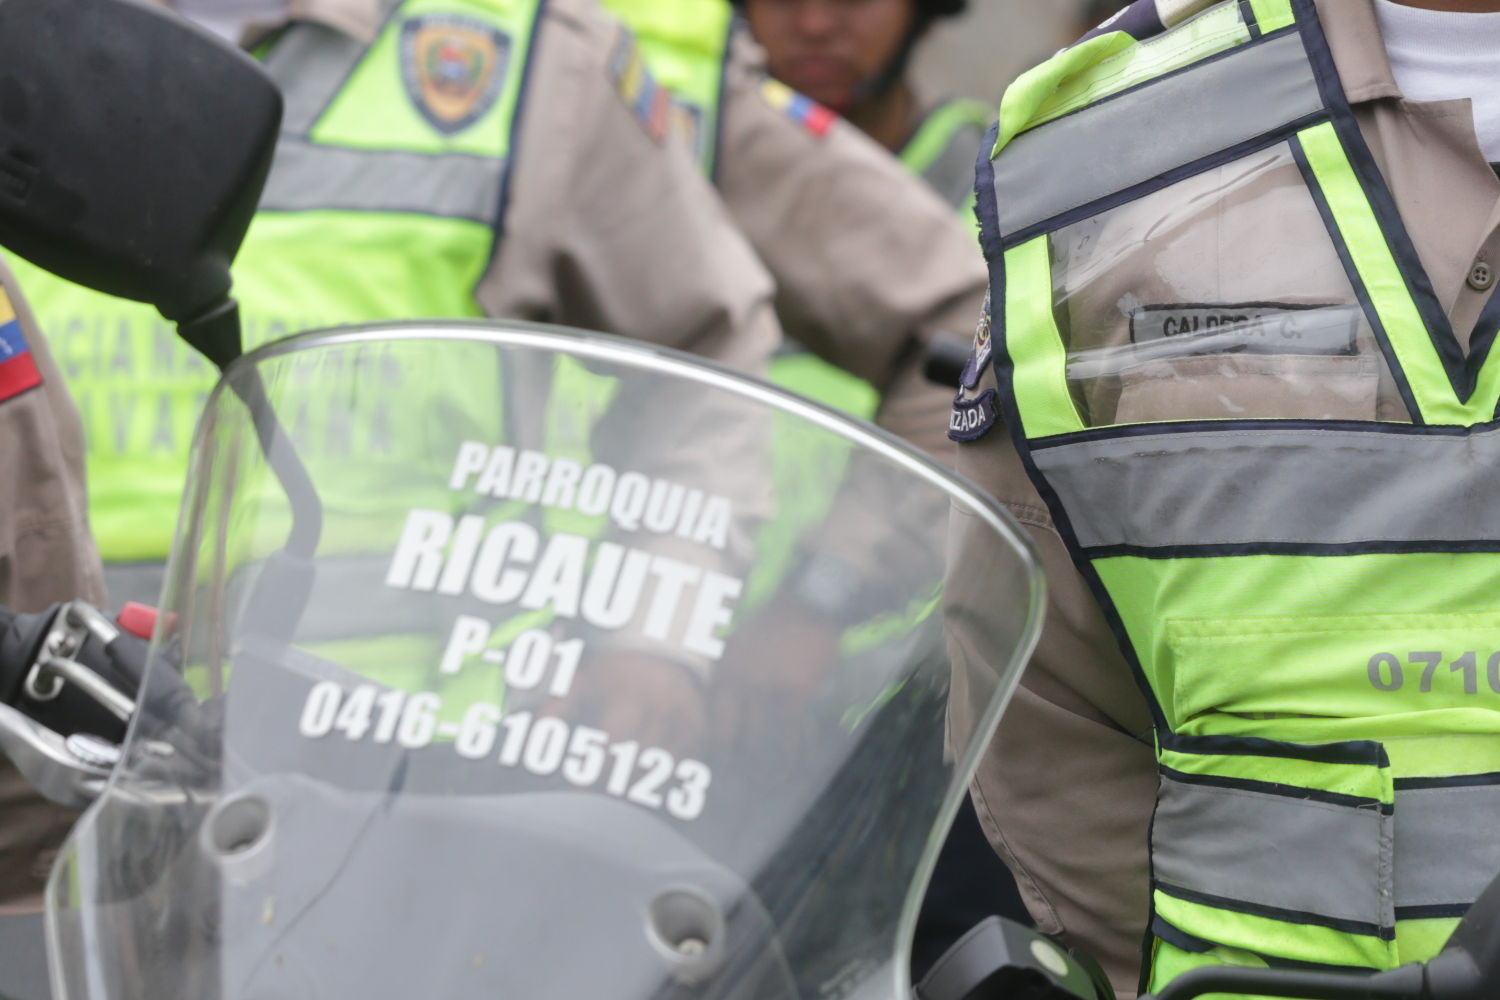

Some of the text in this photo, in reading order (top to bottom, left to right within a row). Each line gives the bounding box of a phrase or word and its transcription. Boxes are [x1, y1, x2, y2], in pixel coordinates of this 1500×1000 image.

[1163, 314, 1267, 338] CALDERA
[449, 440, 733, 549] PARROQUIA
[386, 508, 744, 659] RICAUTE
[440, 615, 584, 697] P-01
[299, 680, 712, 821] 0416-6105123
